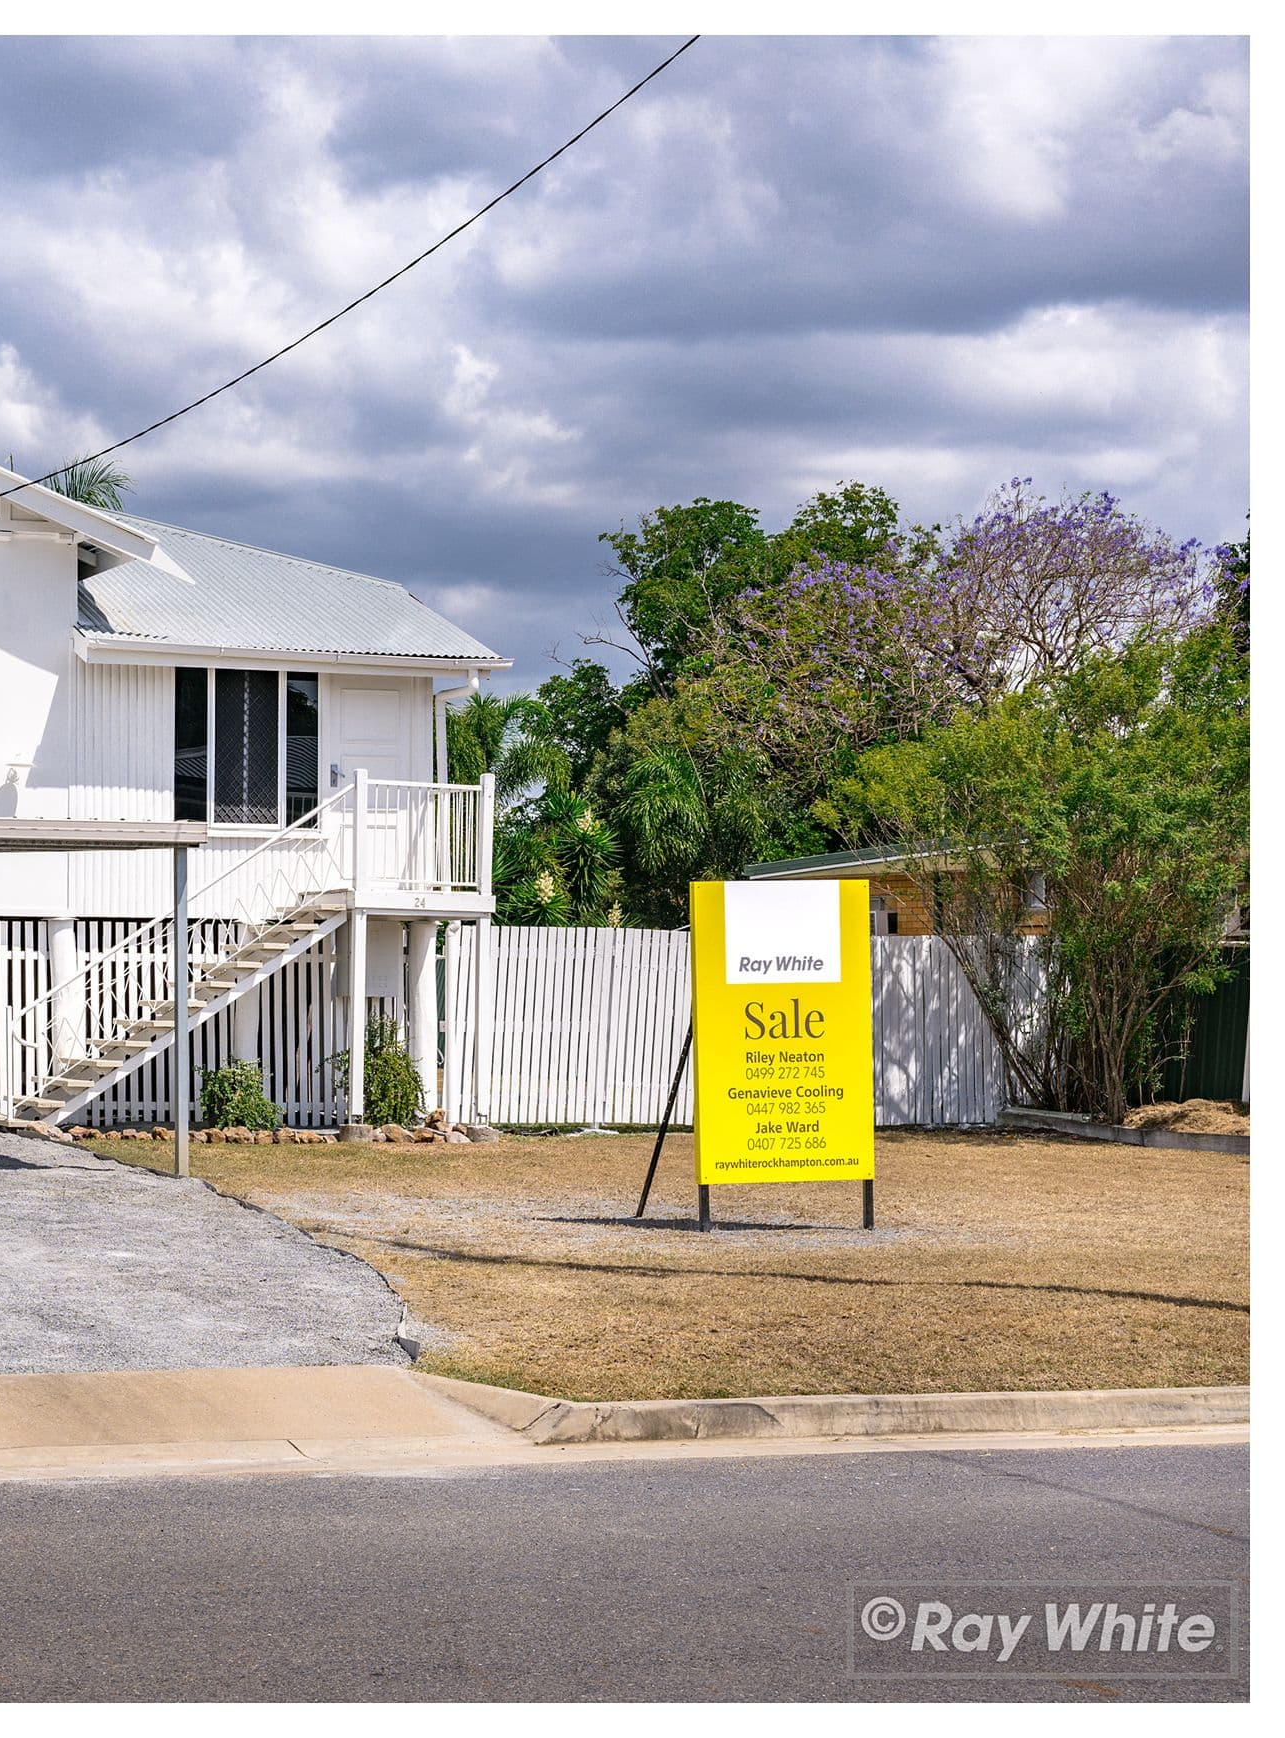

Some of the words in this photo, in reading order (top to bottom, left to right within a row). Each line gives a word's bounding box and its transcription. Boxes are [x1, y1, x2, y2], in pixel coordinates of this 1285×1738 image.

[414, 897, 426, 908] 24
[739, 956, 772, 974] Ray
[776, 956, 823, 971] White
[745, 998, 825, 1040] Sale
[746, 1051, 775, 1065] Riley
[779, 1051, 824, 1062] Neaton
[745, 1067, 775, 1080] 0499
[778, 1067, 799, 1080] 272
[804, 1066, 825, 1079] 745
[728, 1086, 792, 1100] Genavieve
[796, 1086, 844, 1100] Cooling
[746, 1102, 775, 1116] 0447
[778, 1102, 800, 1115] 982
[804, 1102, 826, 1114] 365
[755, 1121, 783, 1134] Jake
[786, 1120, 819, 1133] Ward
[747, 1137, 776, 1150] 0407
[780, 1137, 801, 1150] 725
[805, 1137, 827, 1150] 686
[715, 1158, 859, 1170] raywhiterockhampton.com.au
